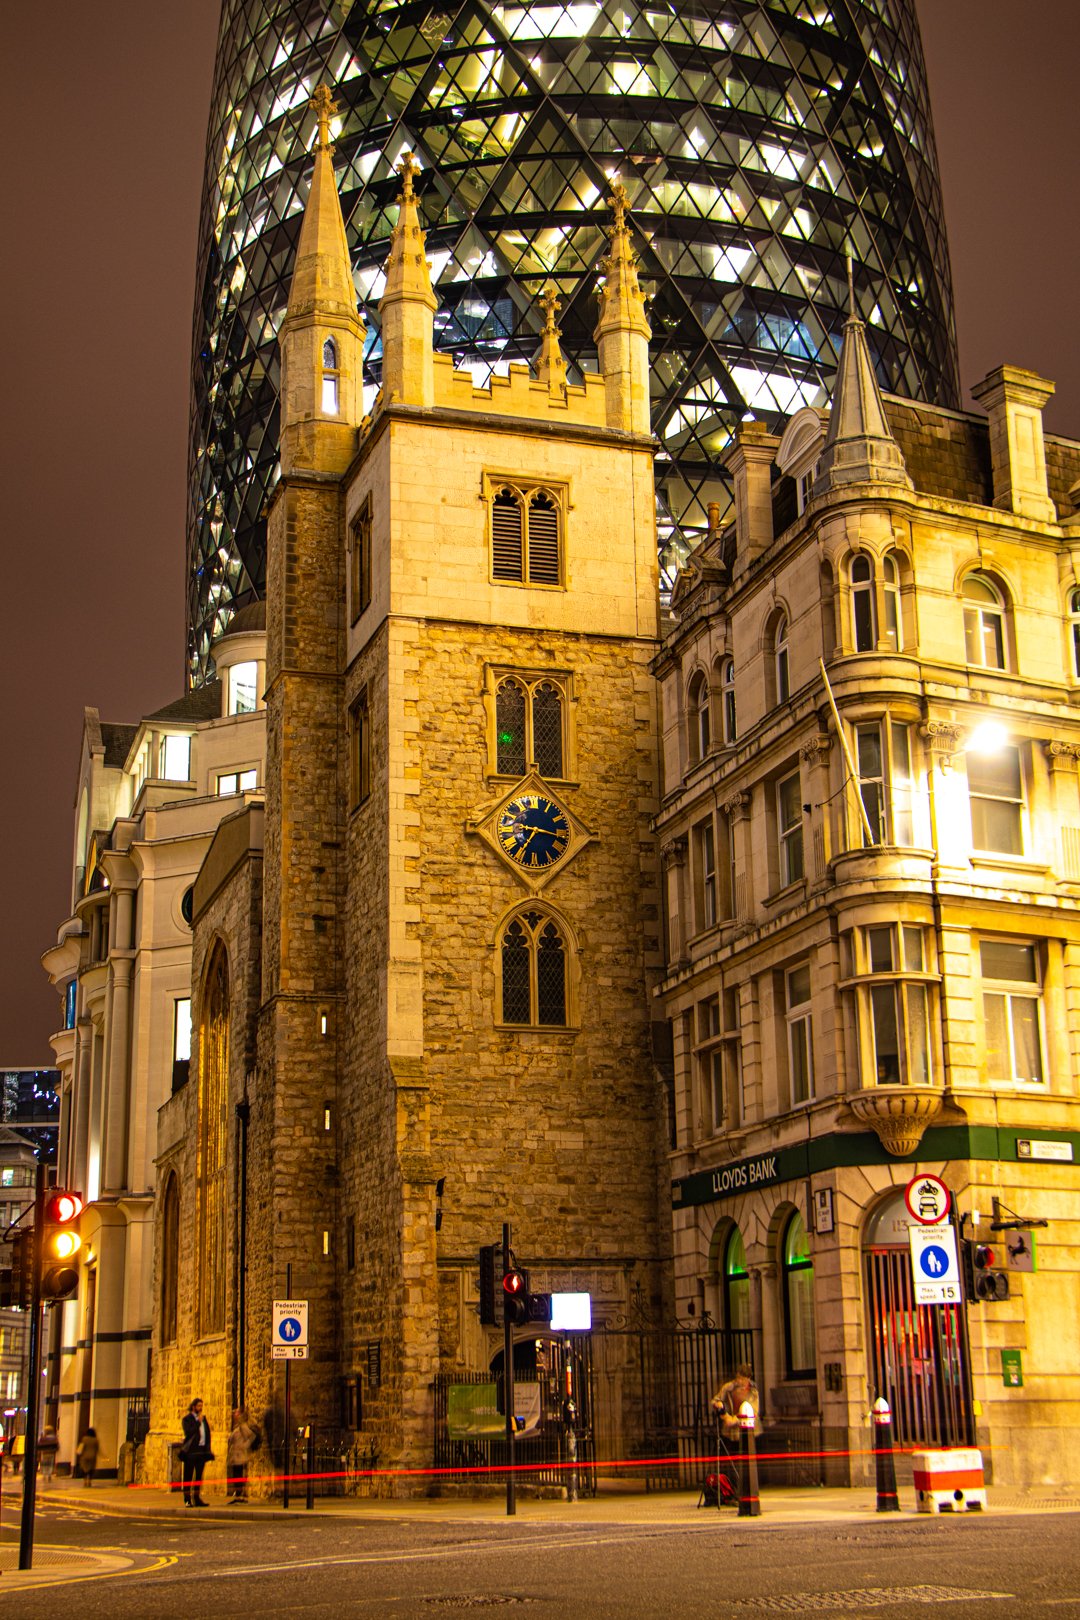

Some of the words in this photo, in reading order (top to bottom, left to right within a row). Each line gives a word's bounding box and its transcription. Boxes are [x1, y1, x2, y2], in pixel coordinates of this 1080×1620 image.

[712, 1165, 748, 1193] LLOYDS
[749, 1156, 777, 1184] BANK
[941, 1287, 955, 1298] 15
[292, 1347, 304, 1358] 15
